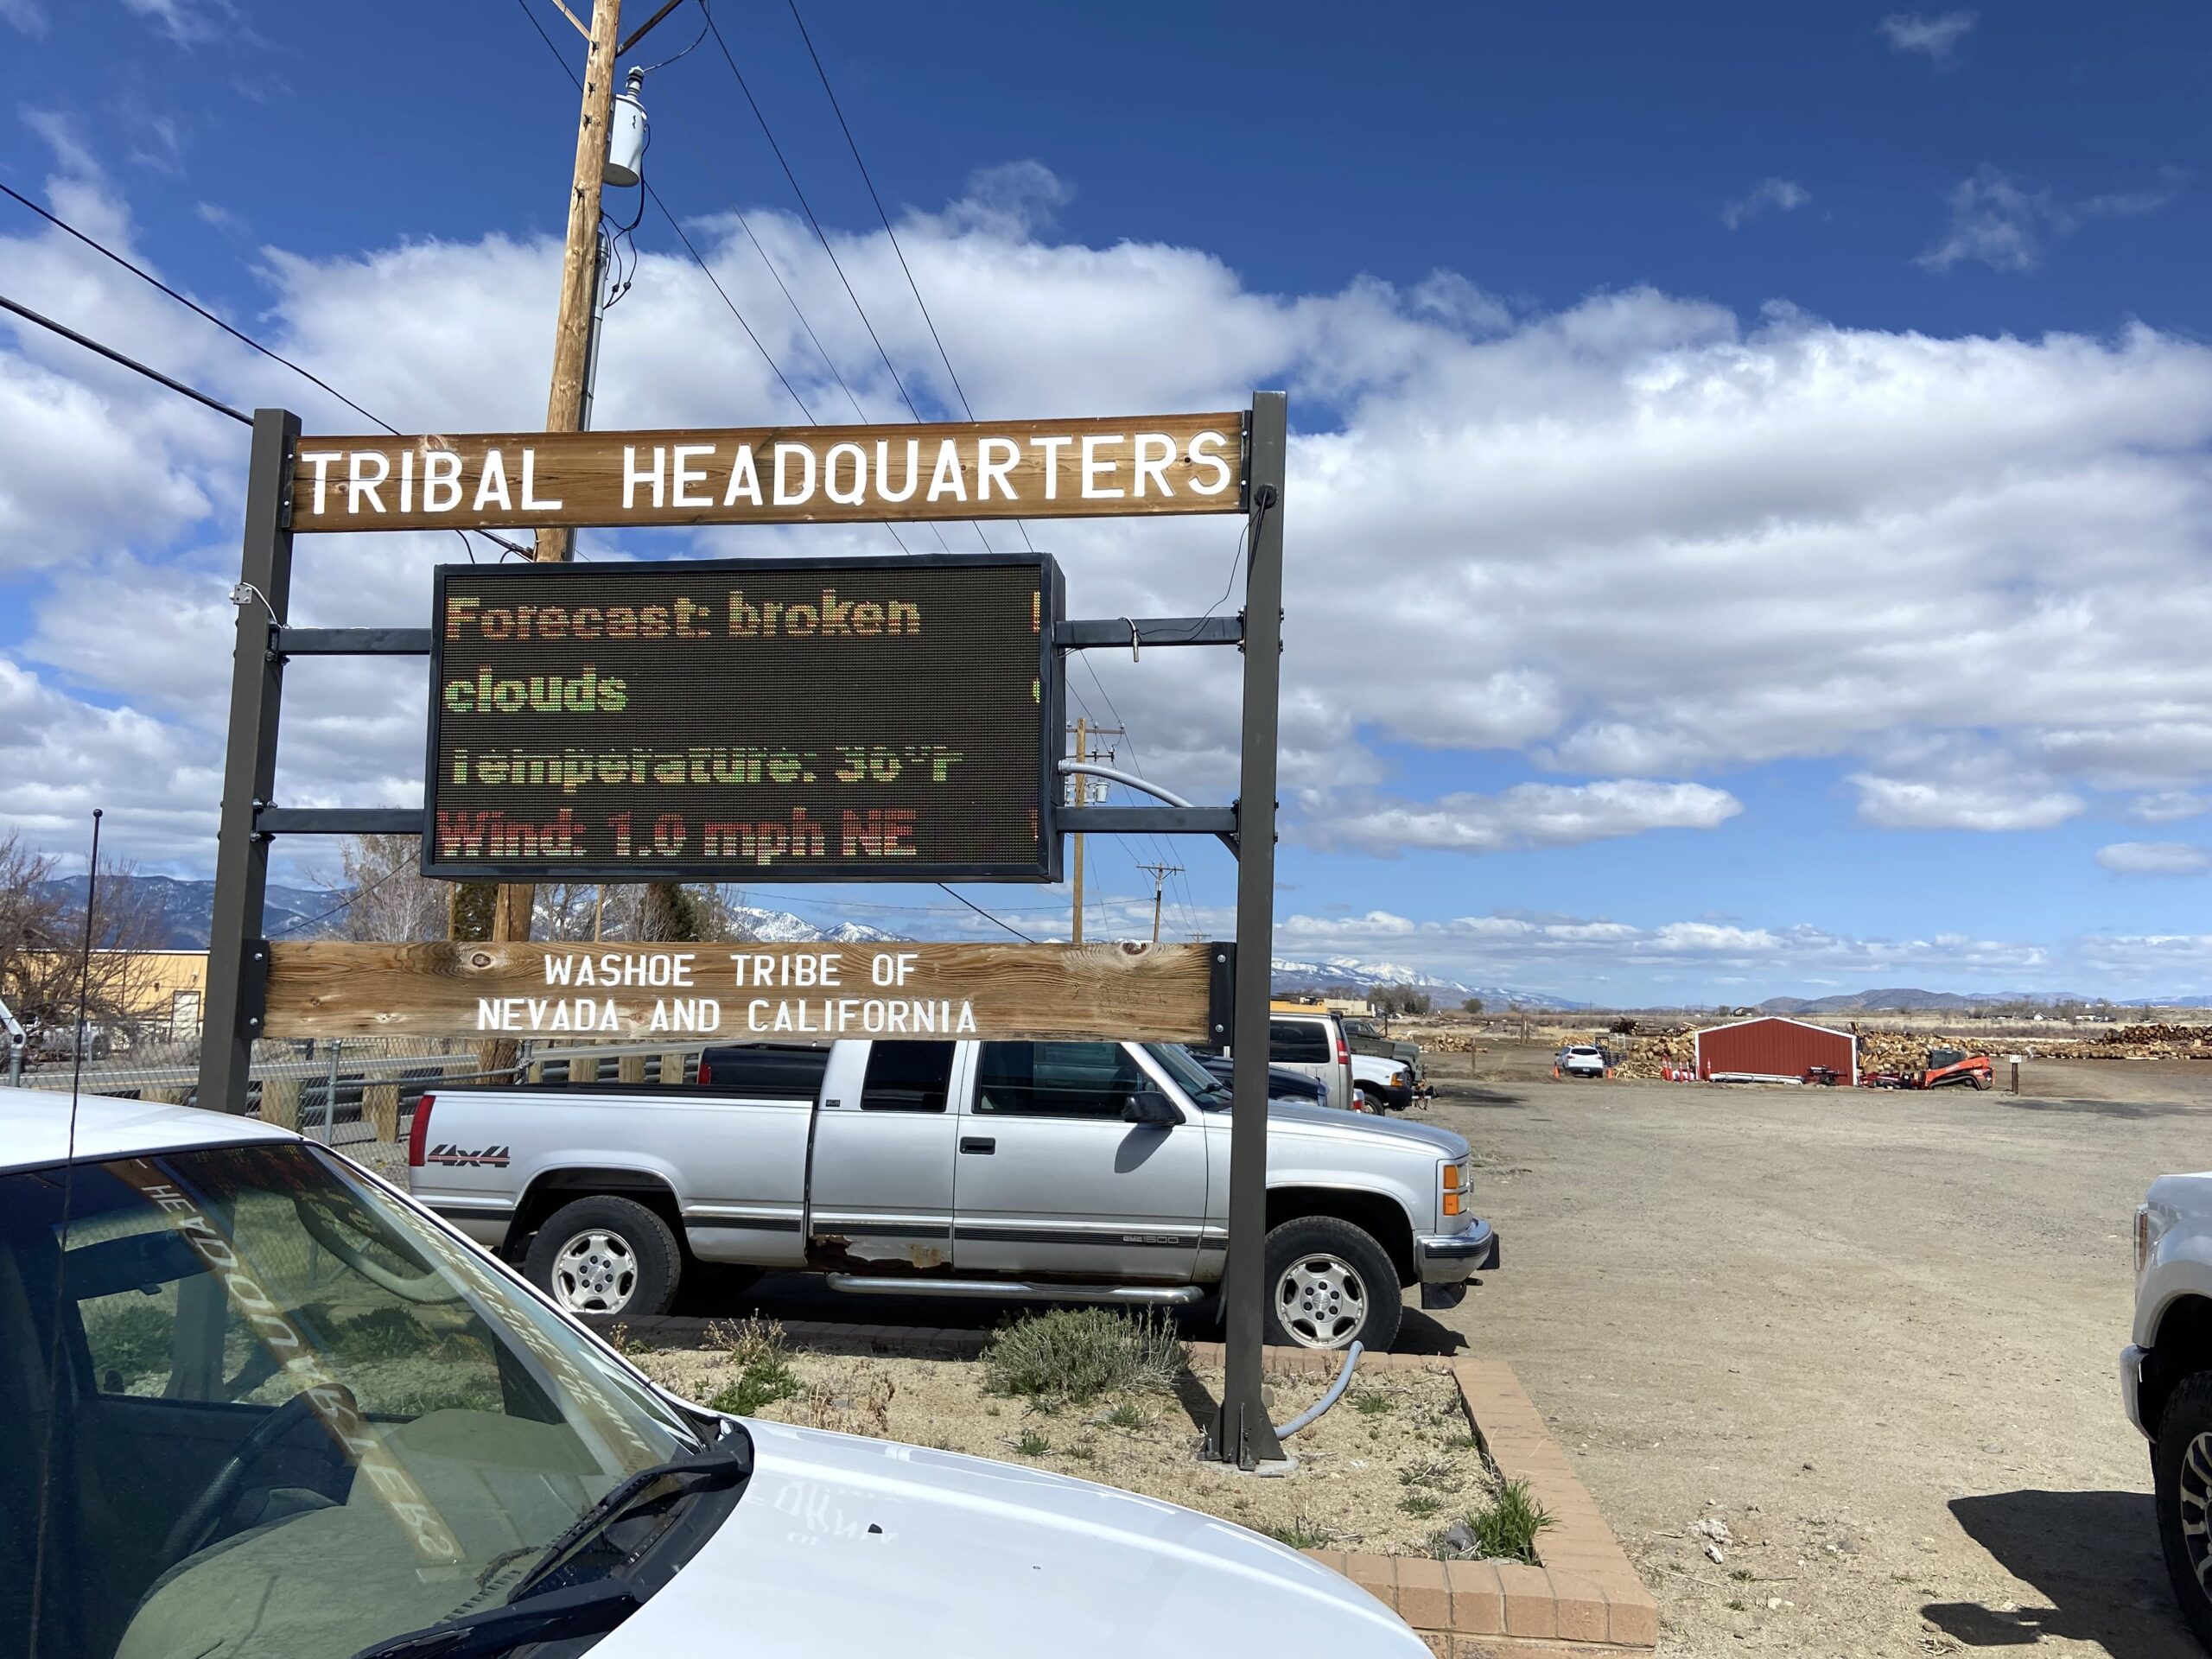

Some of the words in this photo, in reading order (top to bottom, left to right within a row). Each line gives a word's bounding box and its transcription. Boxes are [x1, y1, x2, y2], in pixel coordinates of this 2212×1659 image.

[302, 448, 563, 515] TRIBAL
[622, 429, 1231, 509] HEADQUARTERS
[445, 596, 711, 640] Forecast:
[728, 588, 921, 638] broken
[444, 663, 629, 713] clouds
[436, 808, 587, 856] Wind:
[607, 810, 687, 856] 1.0
[704, 807, 824, 866] mph
[842, 809, 917, 855] NE
[544, 953, 696, 987] WASHOE
[730, 953, 842, 987] TRIBE
[872, 952, 919, 987] OF
[477, 997, 620, 1032] NEVADA
[649, 998, 721, 1032] AND
[747, 999, 977, 1033] CALIFORNIA
